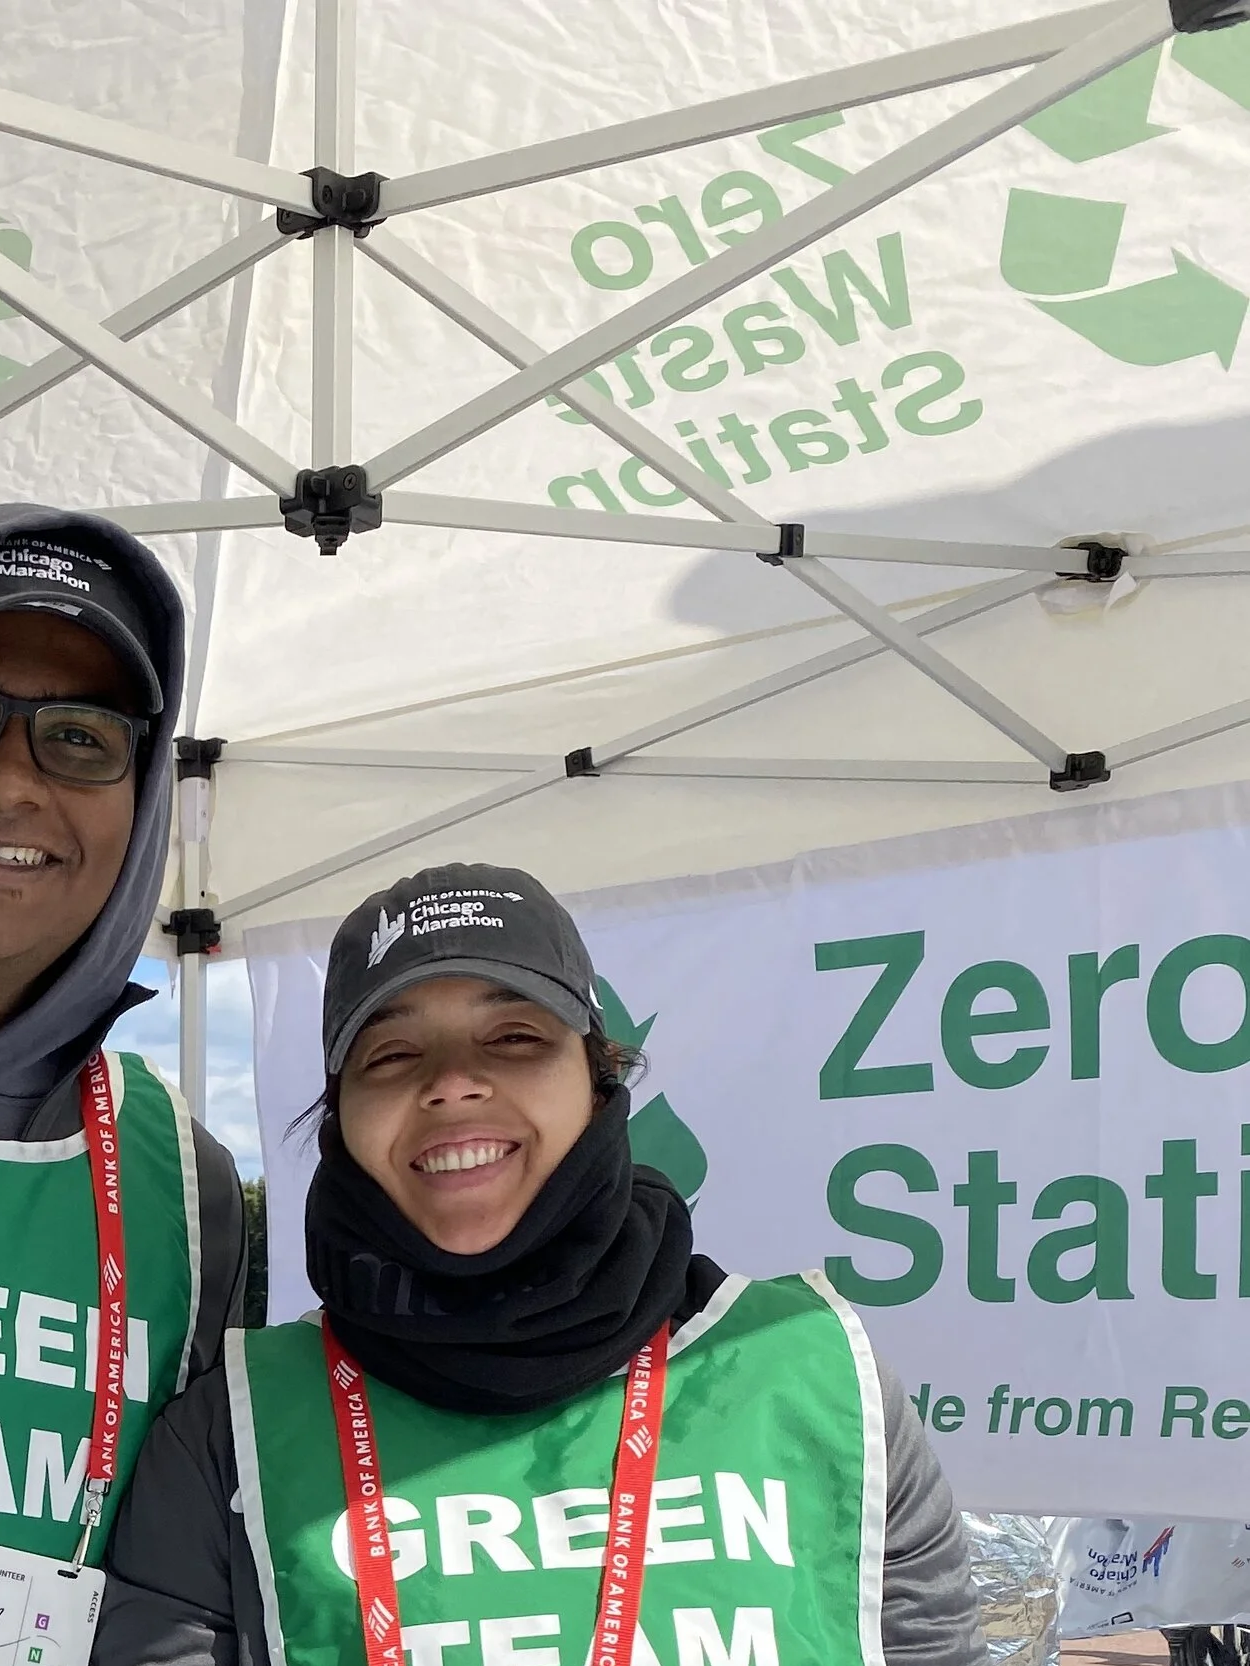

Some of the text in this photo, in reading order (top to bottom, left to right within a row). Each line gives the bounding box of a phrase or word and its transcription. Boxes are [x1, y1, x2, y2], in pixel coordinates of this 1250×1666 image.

[46, 543, 93, 563] AMERICA
[409, 889, 503, 908] BANK OF AMERICA
[410, 901, 485, 922] Chicago
[412, 914, 504, 937] Marathon
[814, 930, 1250, 1100] Zero
[99, 1129, 116, 1154] OF
[104, 1158, 120, 1214] BANK
[101, 1300, 122, 1483] ANK OF AMERICA
[987, 1384, 1135, 1437] from
[1160, 1386, 1250, 1440] Re
[348, 1392, 386, 1558] BANK OF AMERICA
[330, 1472, 796, 1584] GREEN
[614, 1492, 636, 1549] BANK
[612, 1553, 629, 1581] OF
[87, 1590, 99, 1623] ACCESS
